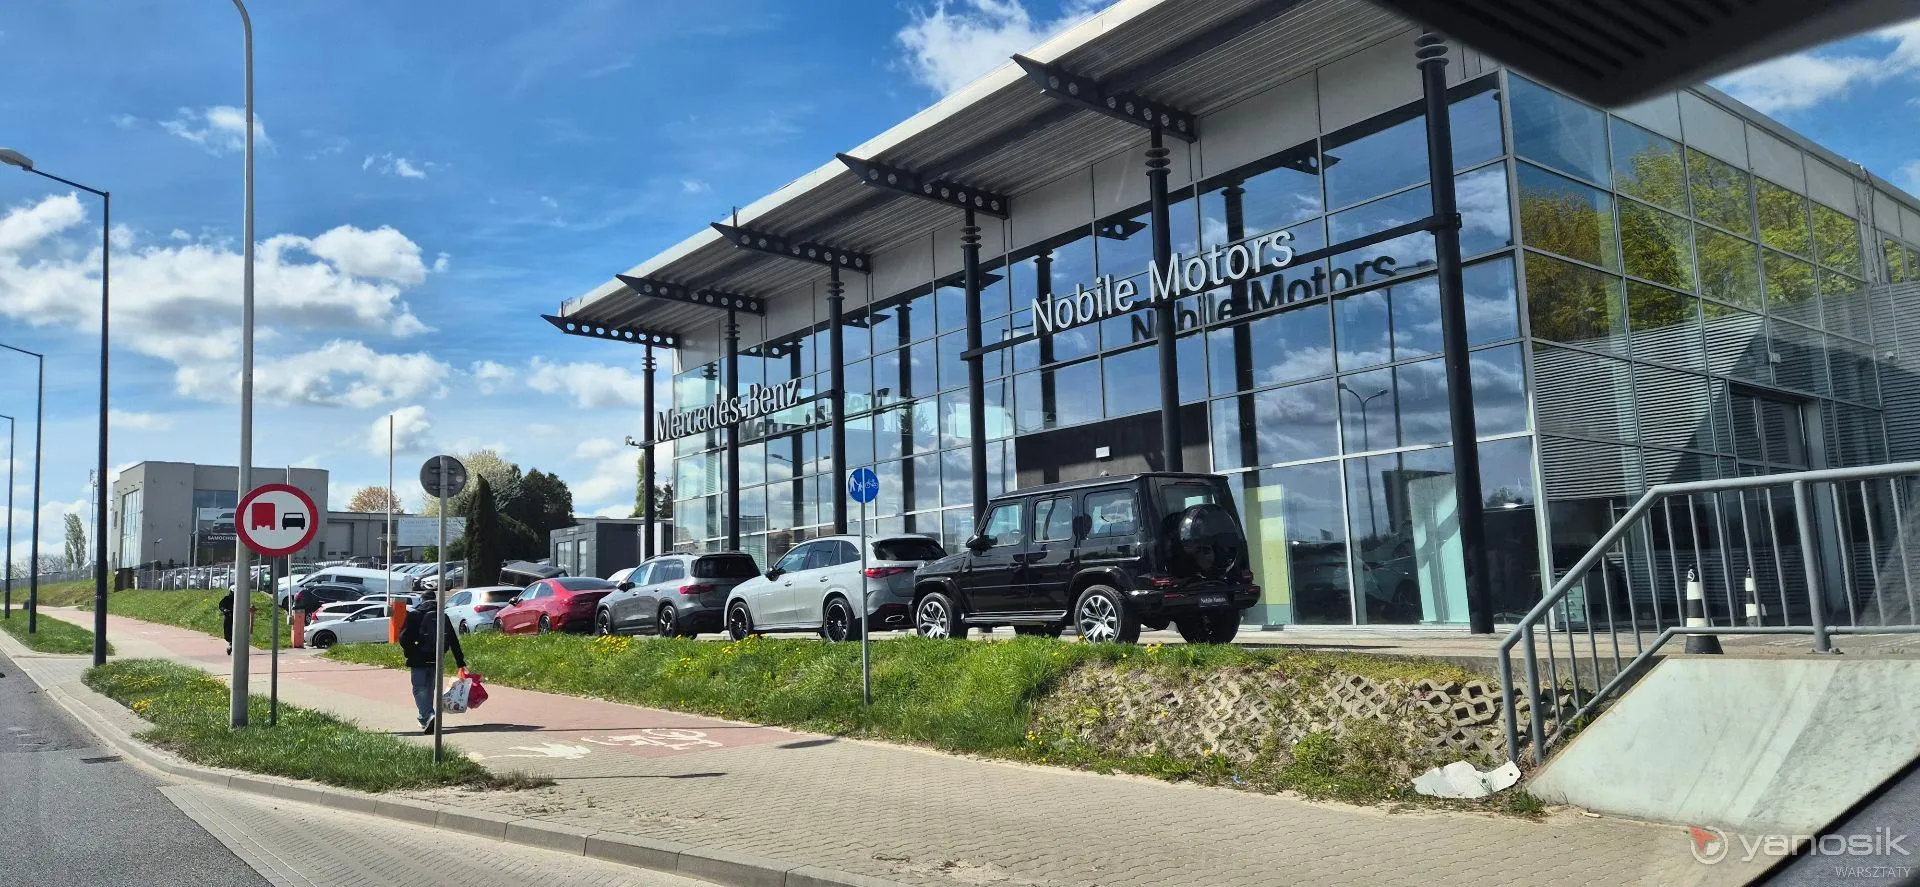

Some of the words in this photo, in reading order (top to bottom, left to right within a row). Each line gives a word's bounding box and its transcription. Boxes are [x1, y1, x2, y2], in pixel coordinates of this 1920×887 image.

[1031, 273, 1135, 337] Nobile
[1148, 229, 1295, 304] Motors
[656, 378, 800, 442] Mercedes-Benz
